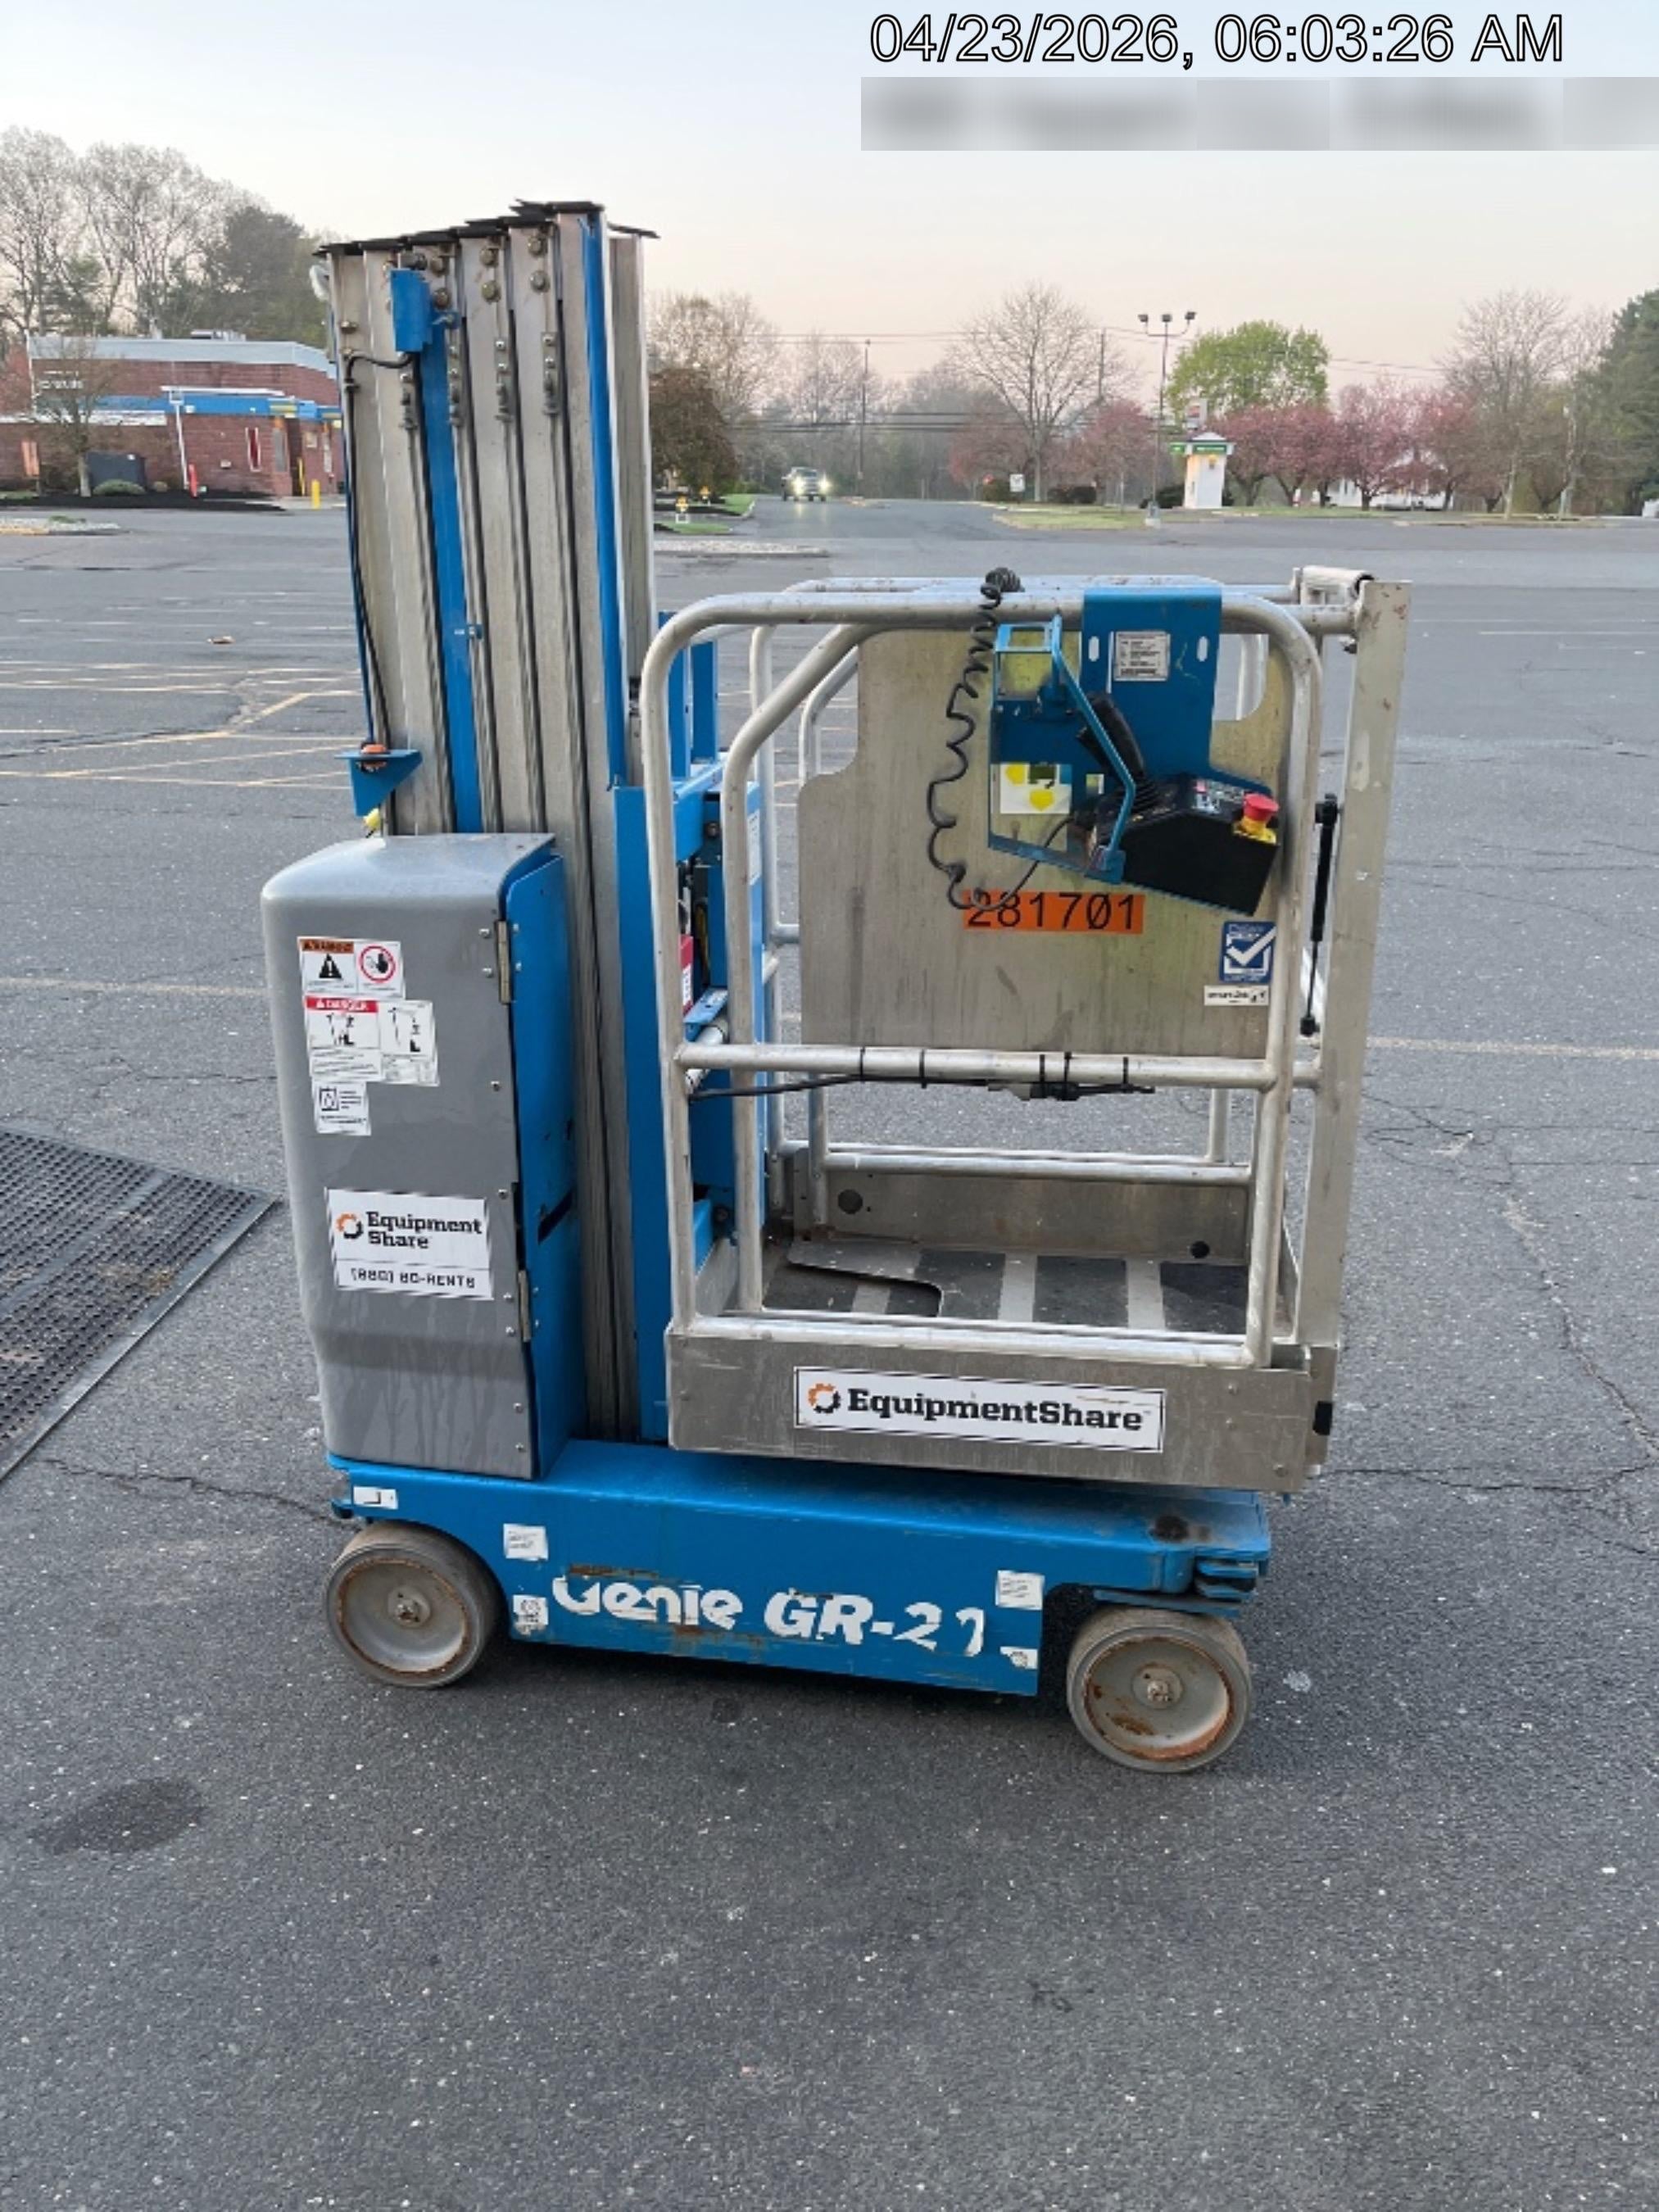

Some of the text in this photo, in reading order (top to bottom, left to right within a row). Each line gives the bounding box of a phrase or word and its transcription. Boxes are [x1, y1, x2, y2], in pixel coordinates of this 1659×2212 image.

[968, 891, 1134, 930] 281701
[365, 1211, 483, 1234] Equipment
[368, 1231, 429, 1249] Share
[847, 1387, 1143, 1431] EquipmentShare
[551, 1574, 744, 1631] Genie
